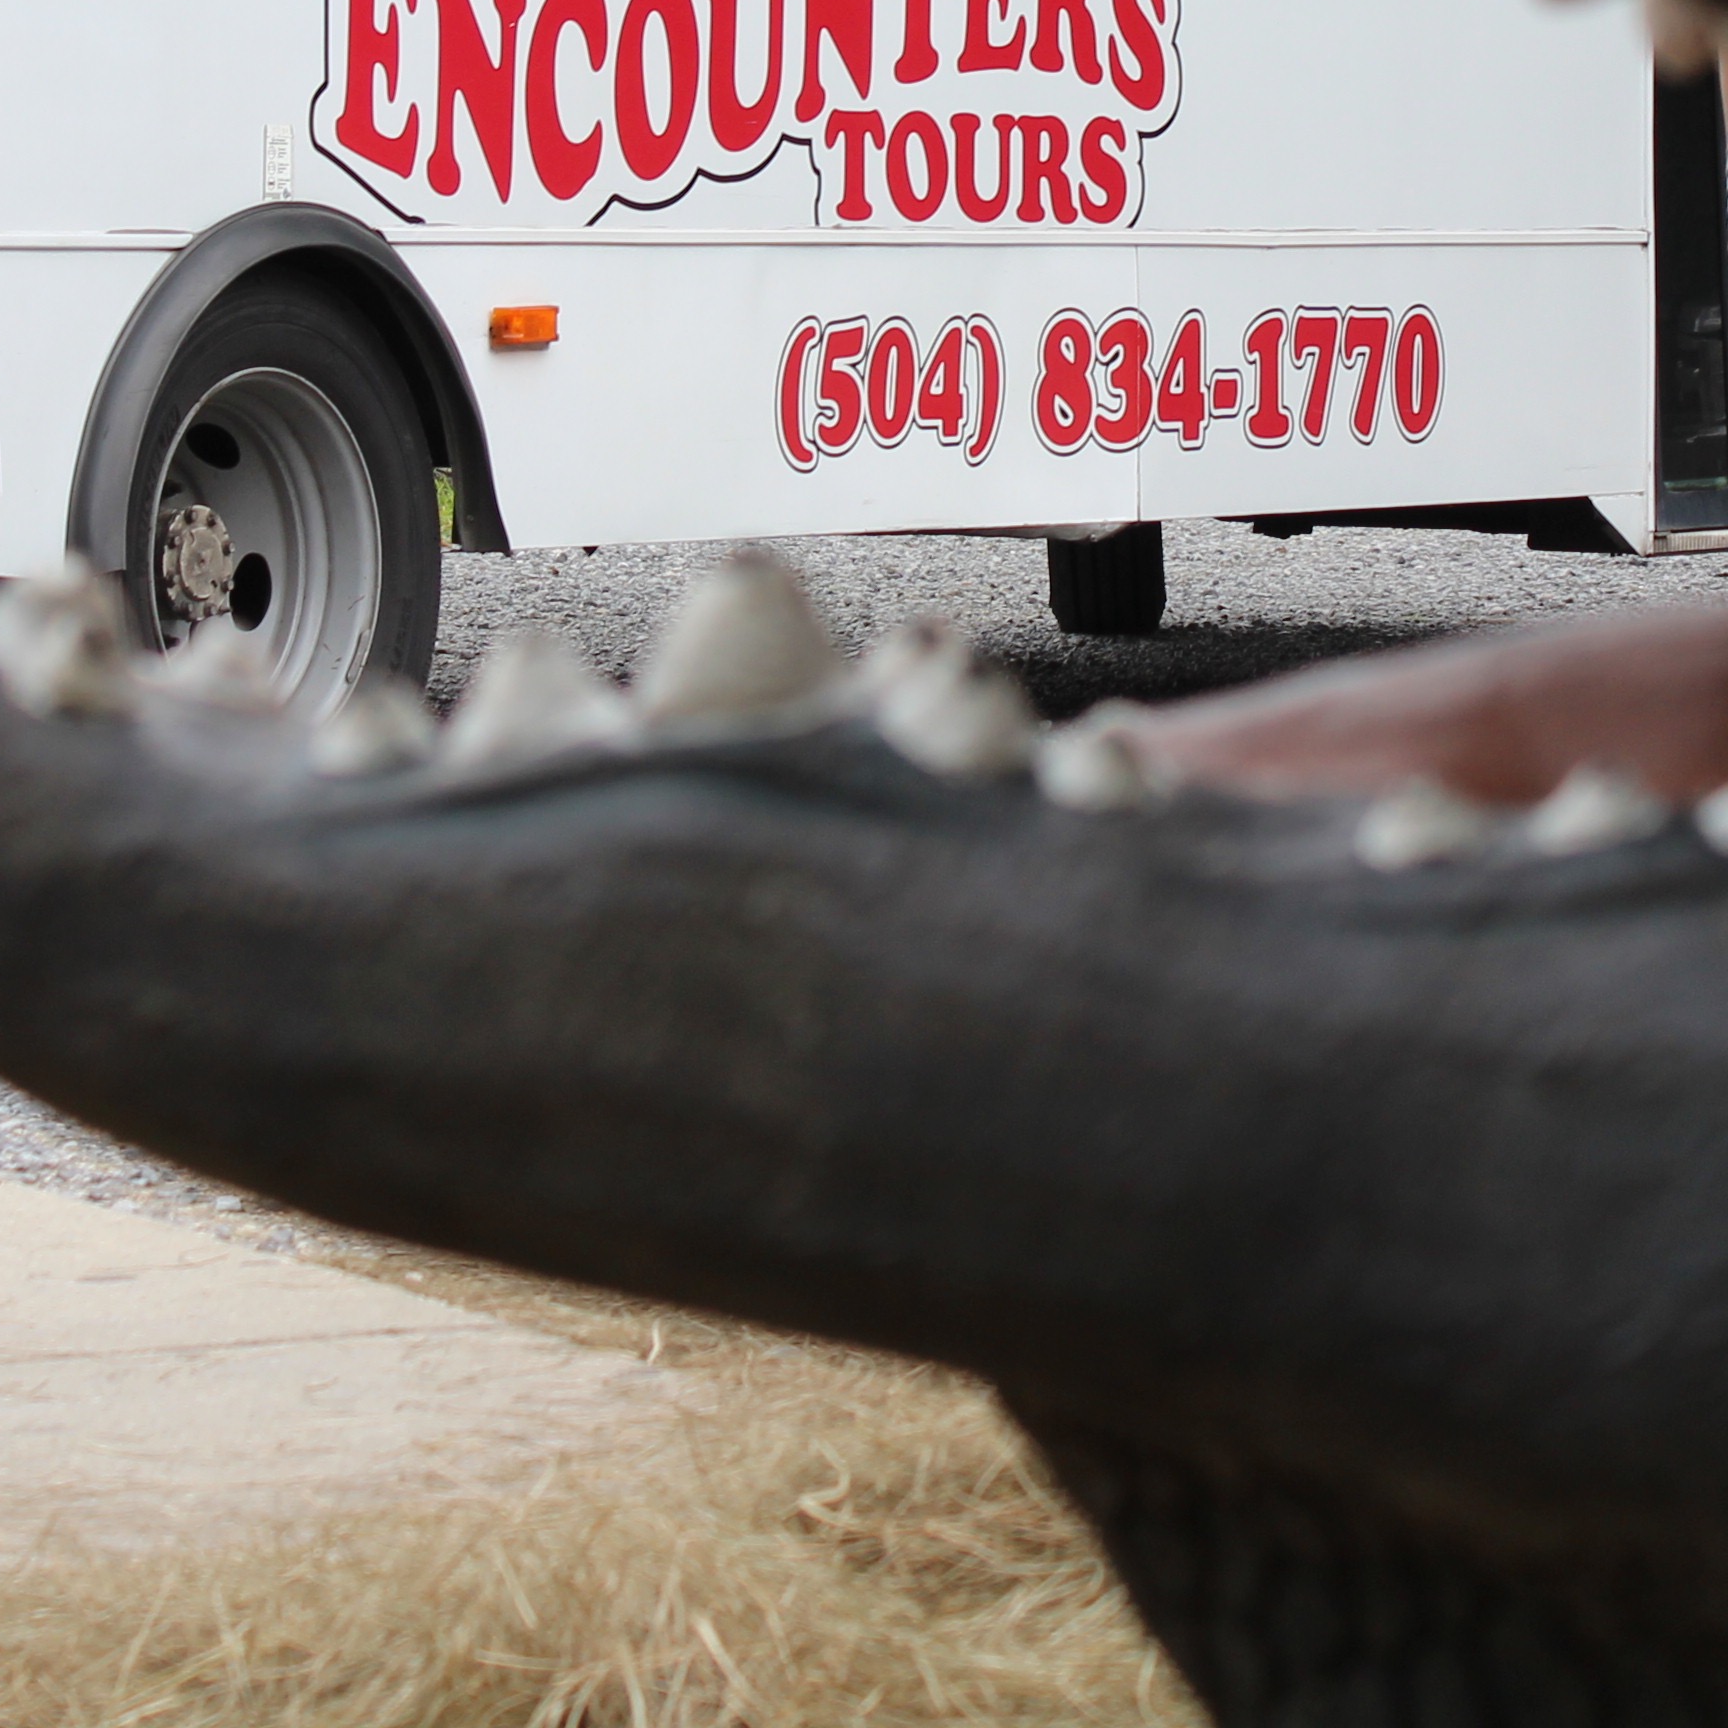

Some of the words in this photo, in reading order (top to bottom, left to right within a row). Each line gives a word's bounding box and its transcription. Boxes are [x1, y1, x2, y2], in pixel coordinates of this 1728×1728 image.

[825, 109, 1127, 225] TOURS
[781, 323, 1000, 466] (504)
[1036, 313, 1440, 449] 834-1770
